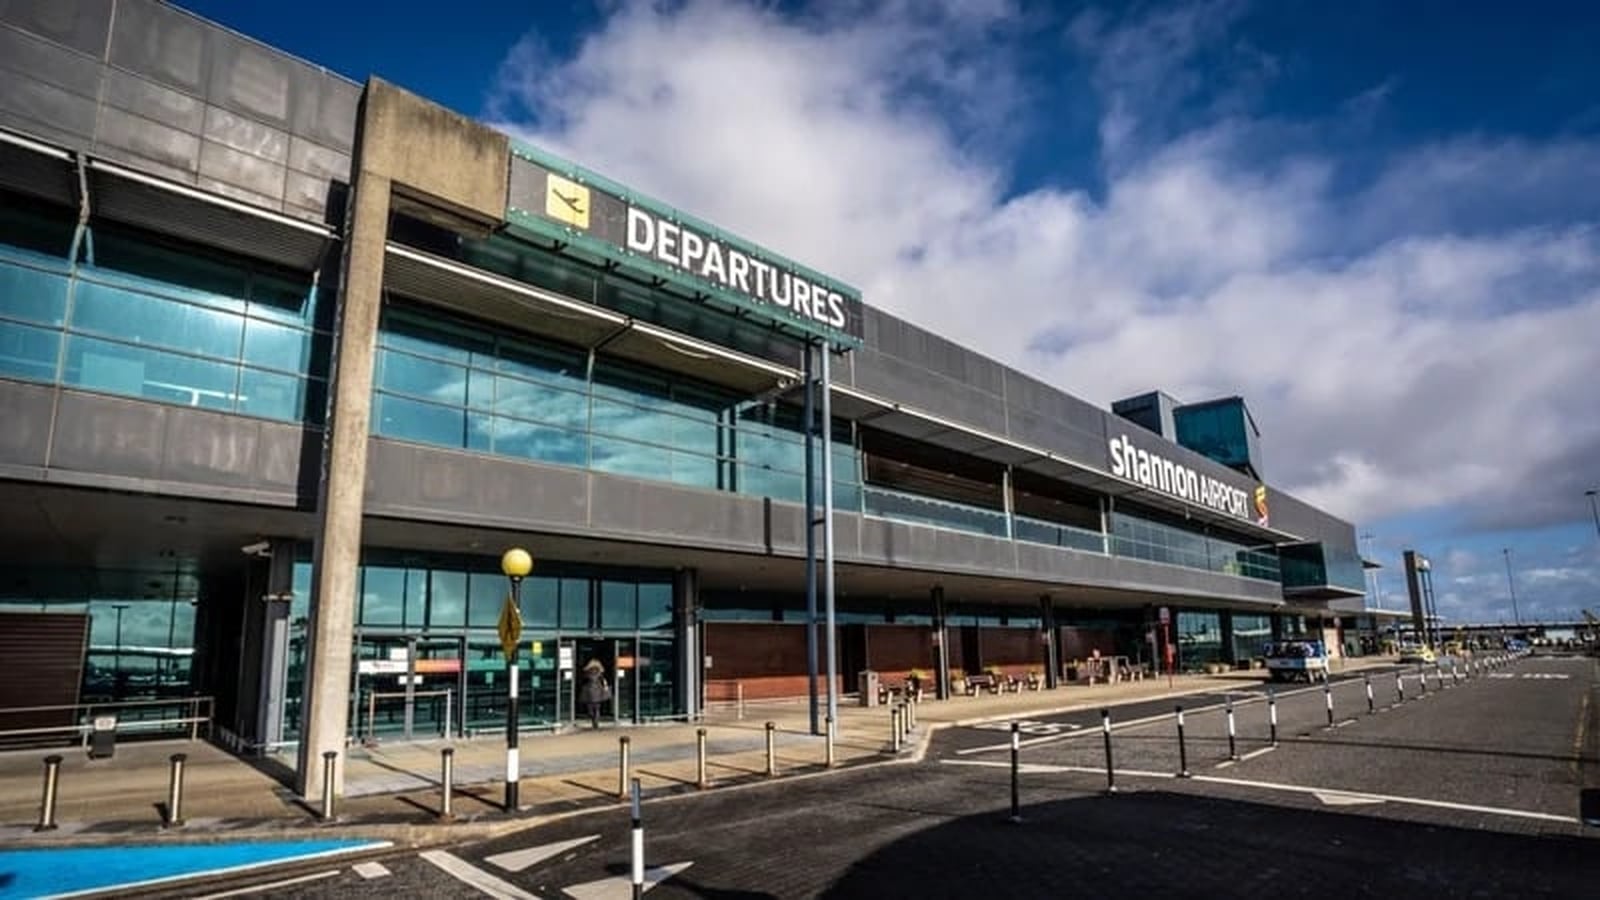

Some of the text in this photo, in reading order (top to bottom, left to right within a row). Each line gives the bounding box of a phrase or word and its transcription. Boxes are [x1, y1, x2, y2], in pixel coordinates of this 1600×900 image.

[627, 207, 845, 327] DEPARTURES
[1110, 435, 1249, 518] shannon AIRPORT
